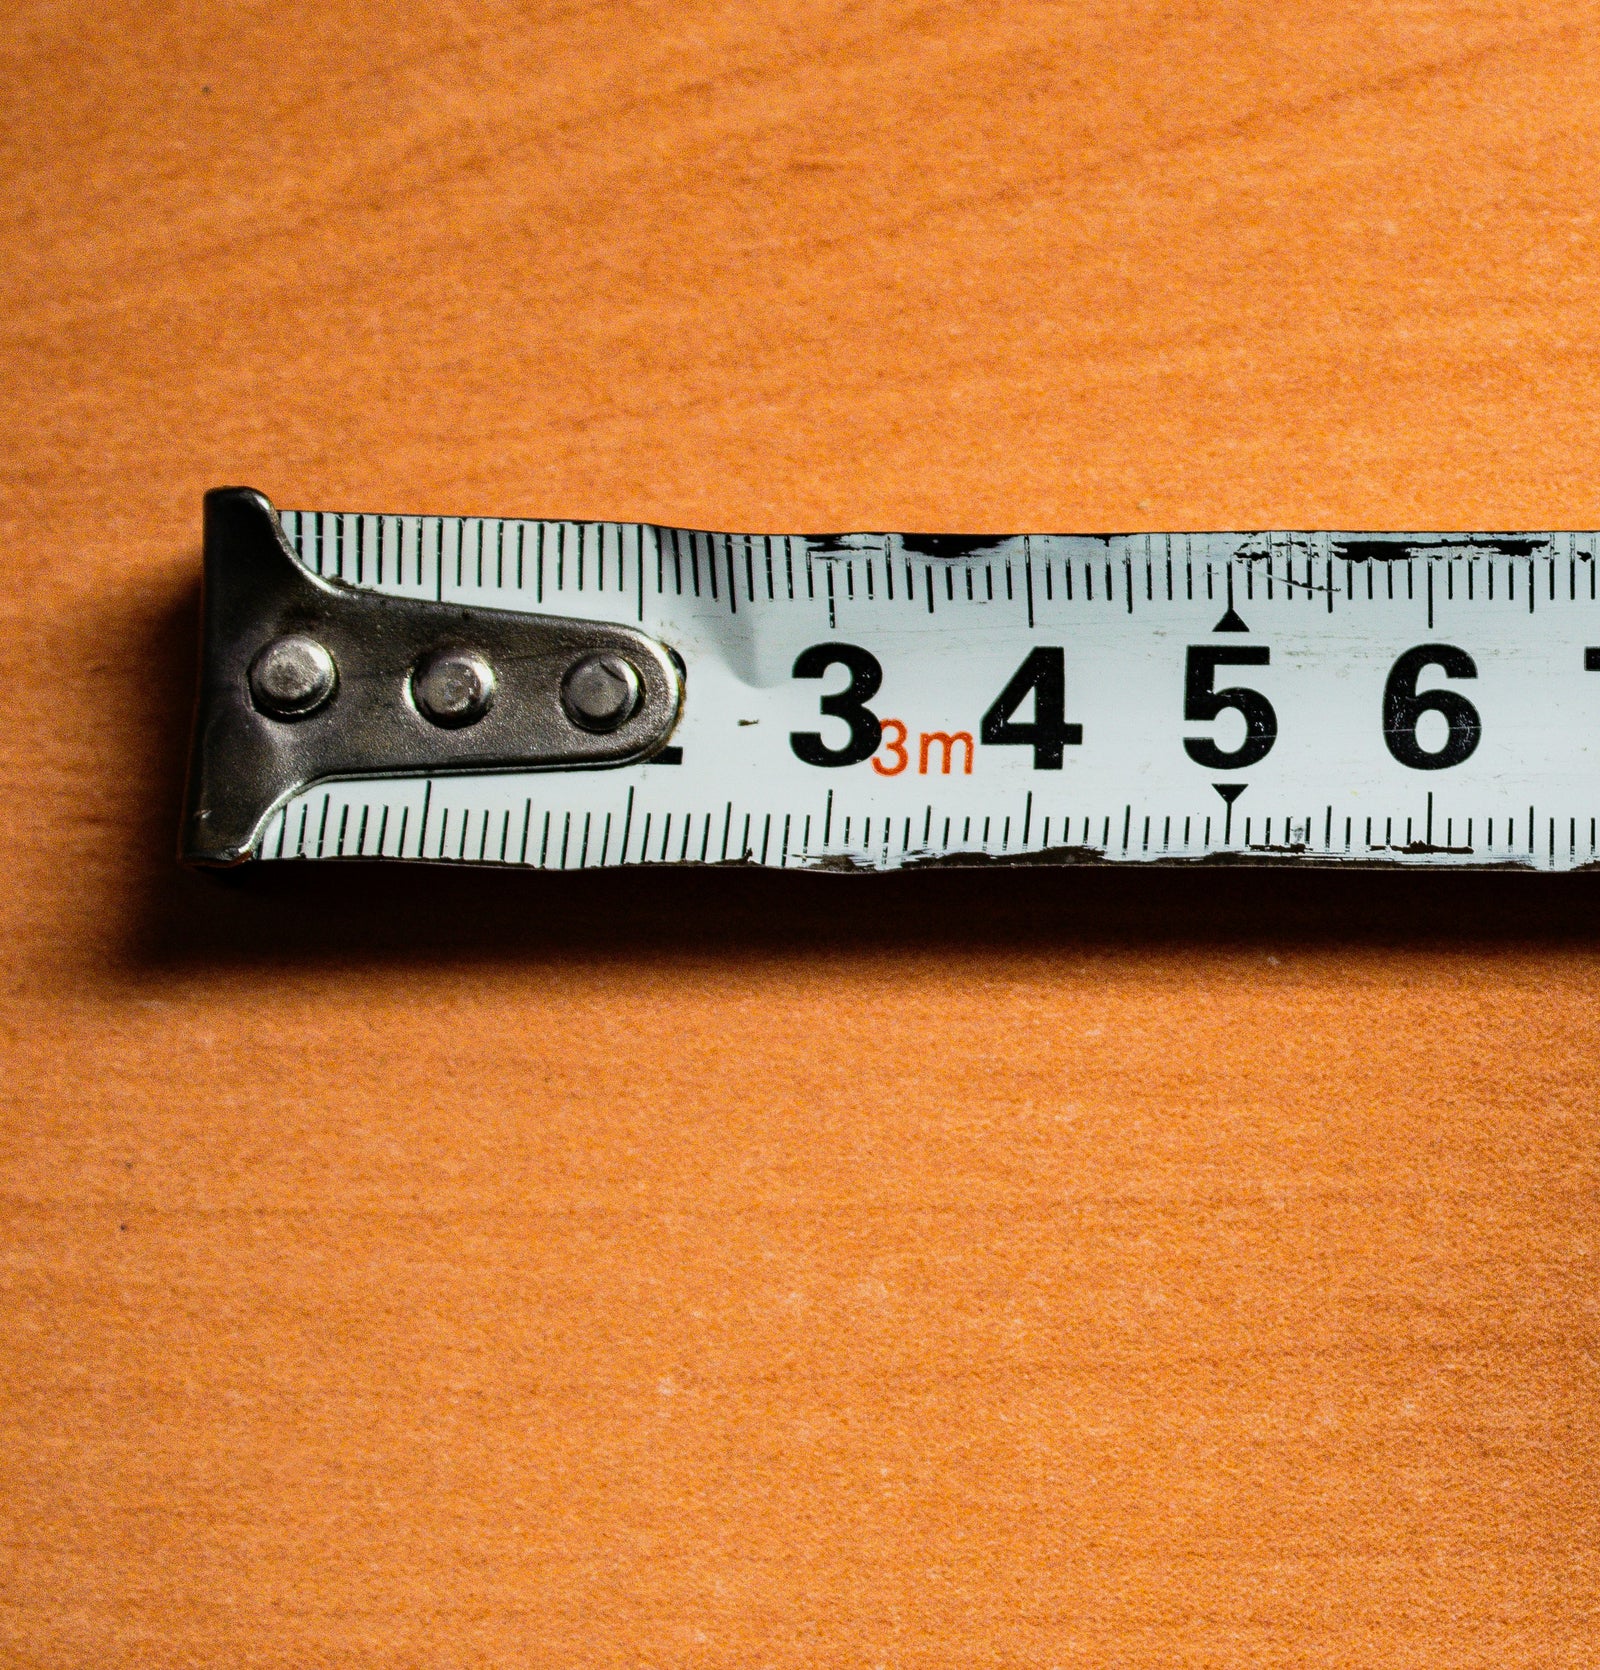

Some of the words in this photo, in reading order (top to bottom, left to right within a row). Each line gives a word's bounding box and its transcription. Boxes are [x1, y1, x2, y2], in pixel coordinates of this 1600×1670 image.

[790, 641, 884, 768] 3
[979, 645, 1083, 771] 4
[1182, 643, 1278, 770] 5
[1382, 642, 1483, 771] 6
[870, 717, 974, 777] 3m
